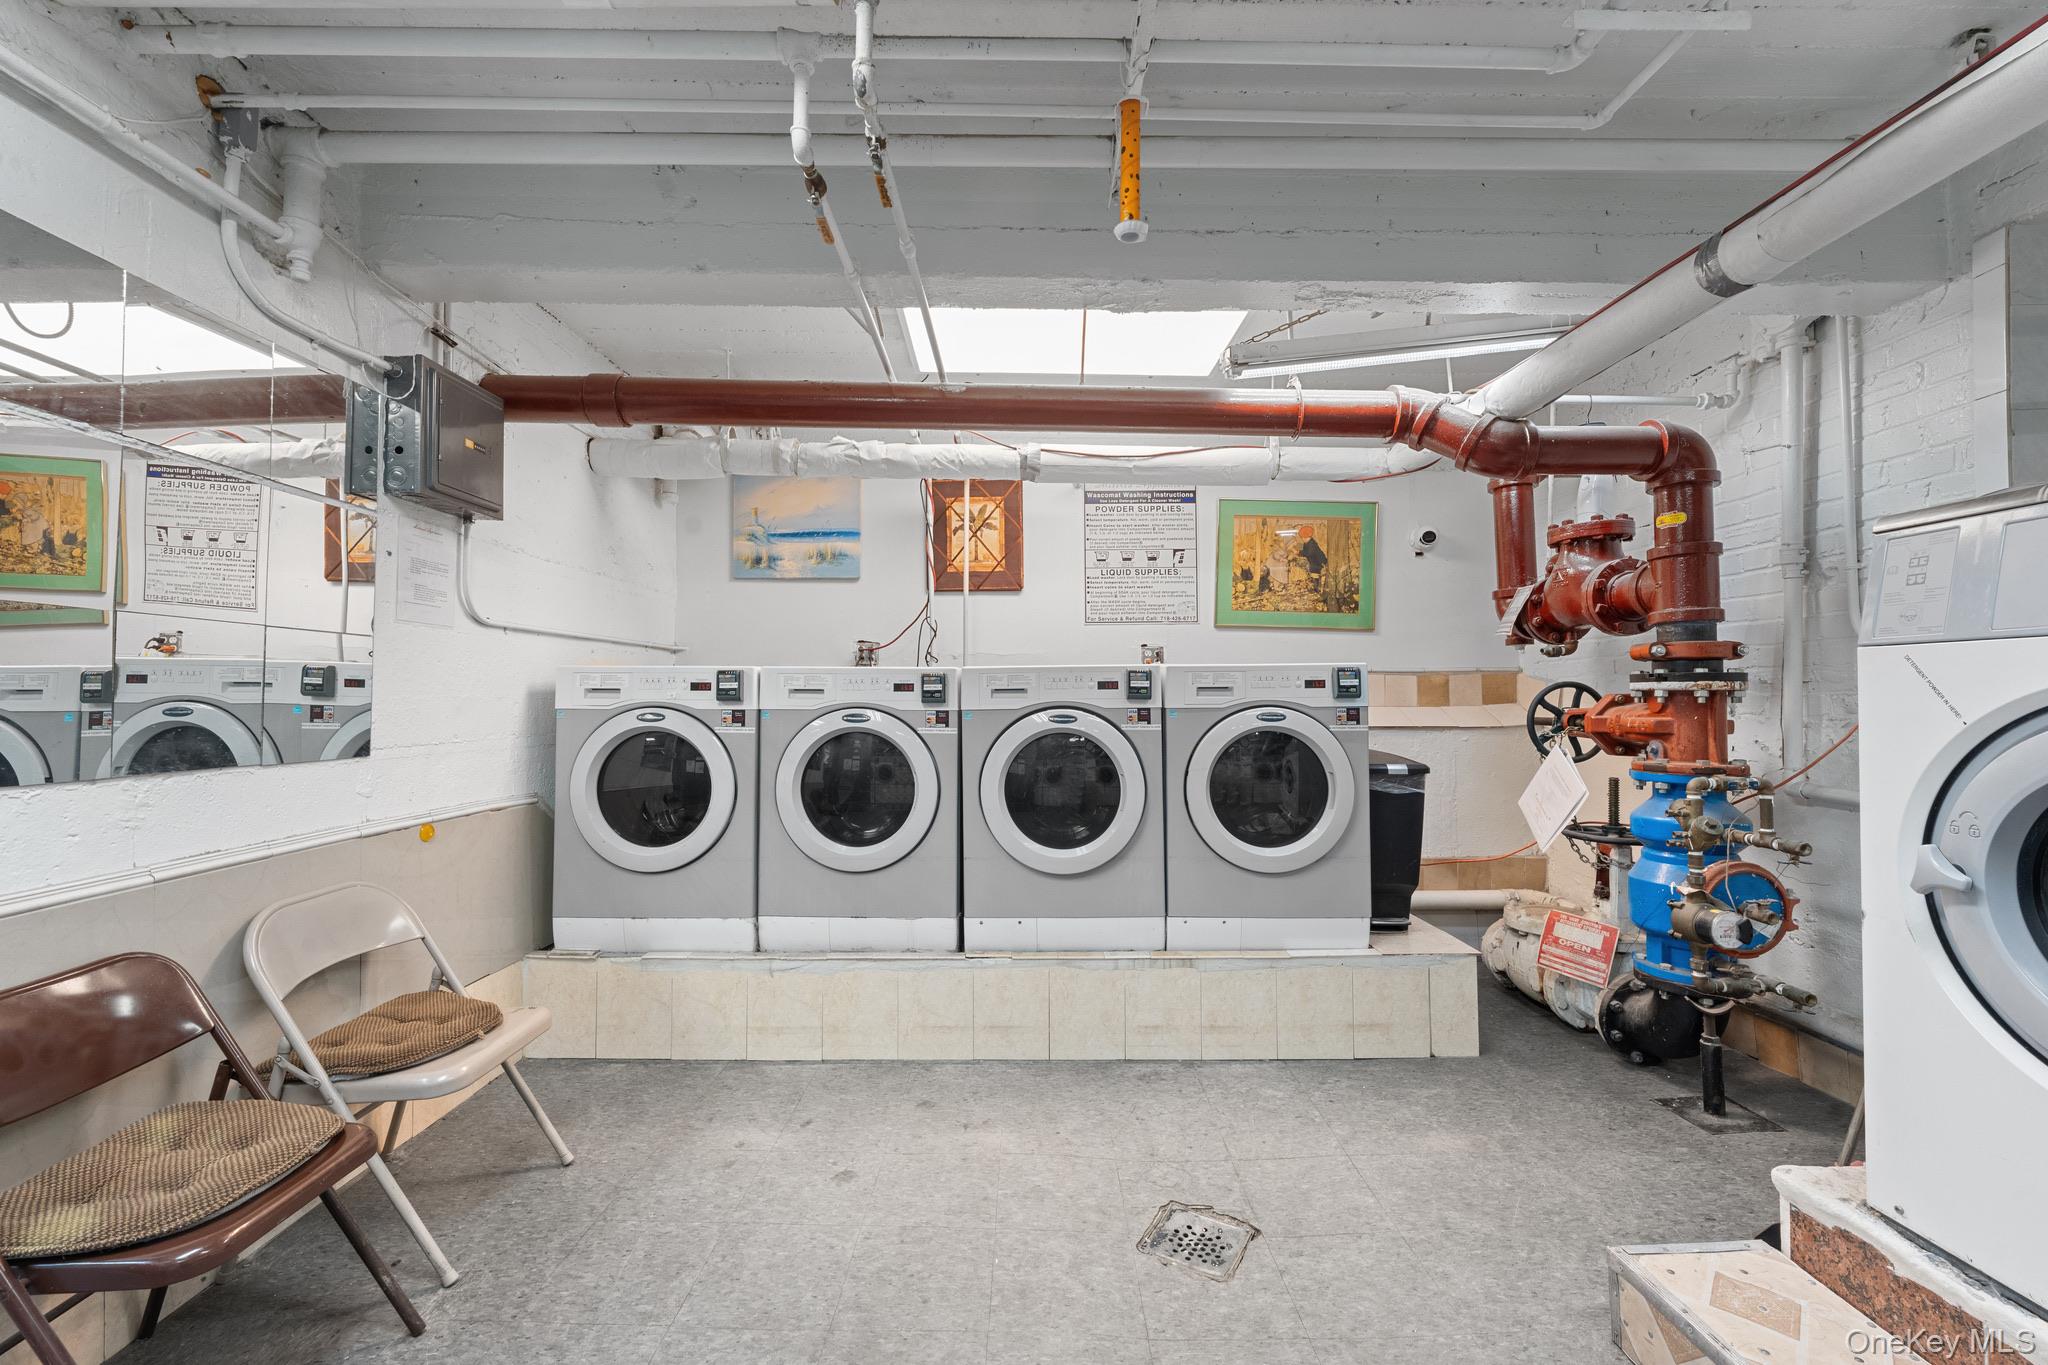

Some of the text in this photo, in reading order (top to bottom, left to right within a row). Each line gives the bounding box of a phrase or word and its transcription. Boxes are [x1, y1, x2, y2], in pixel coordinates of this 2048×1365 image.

[1904, 655, 1928, 680] DETERGENT
[1926, 680, 1945, 700] POWDER
[1559, 939, 1591, 953] OPEN
